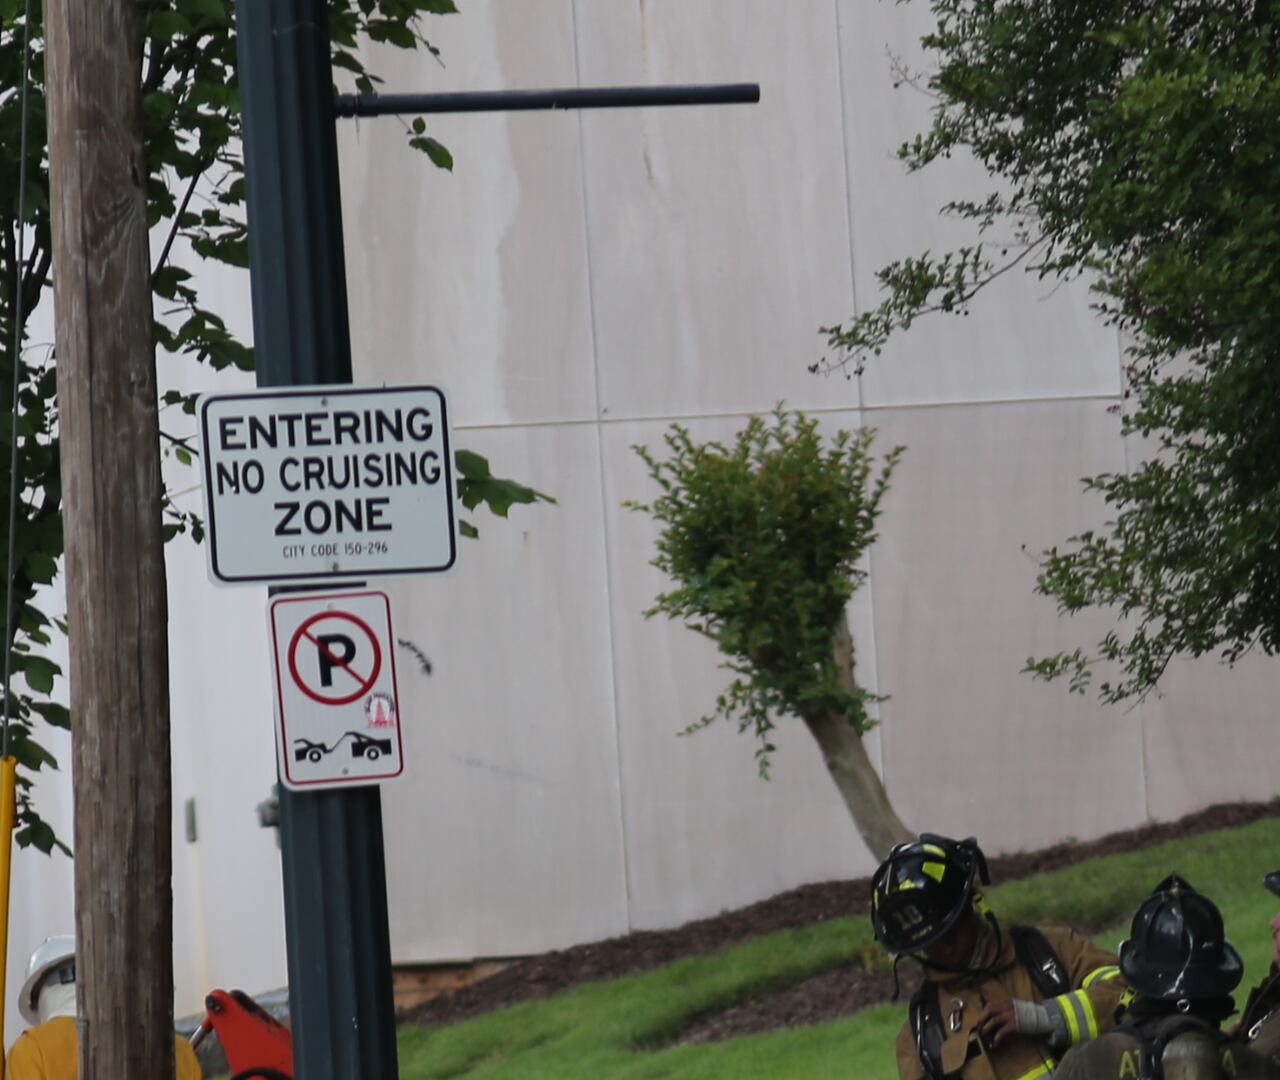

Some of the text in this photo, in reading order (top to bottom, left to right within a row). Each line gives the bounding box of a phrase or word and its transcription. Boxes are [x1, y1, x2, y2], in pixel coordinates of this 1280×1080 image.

[219, 407, 433, 450] ENTERING
[216, 450, 441, 495] NO CRUISING
[274, 497, 392, 536] ZONE
[282, 541, 388, 559] CITY CODE 150-296
[317, 633, 356, 687] P
